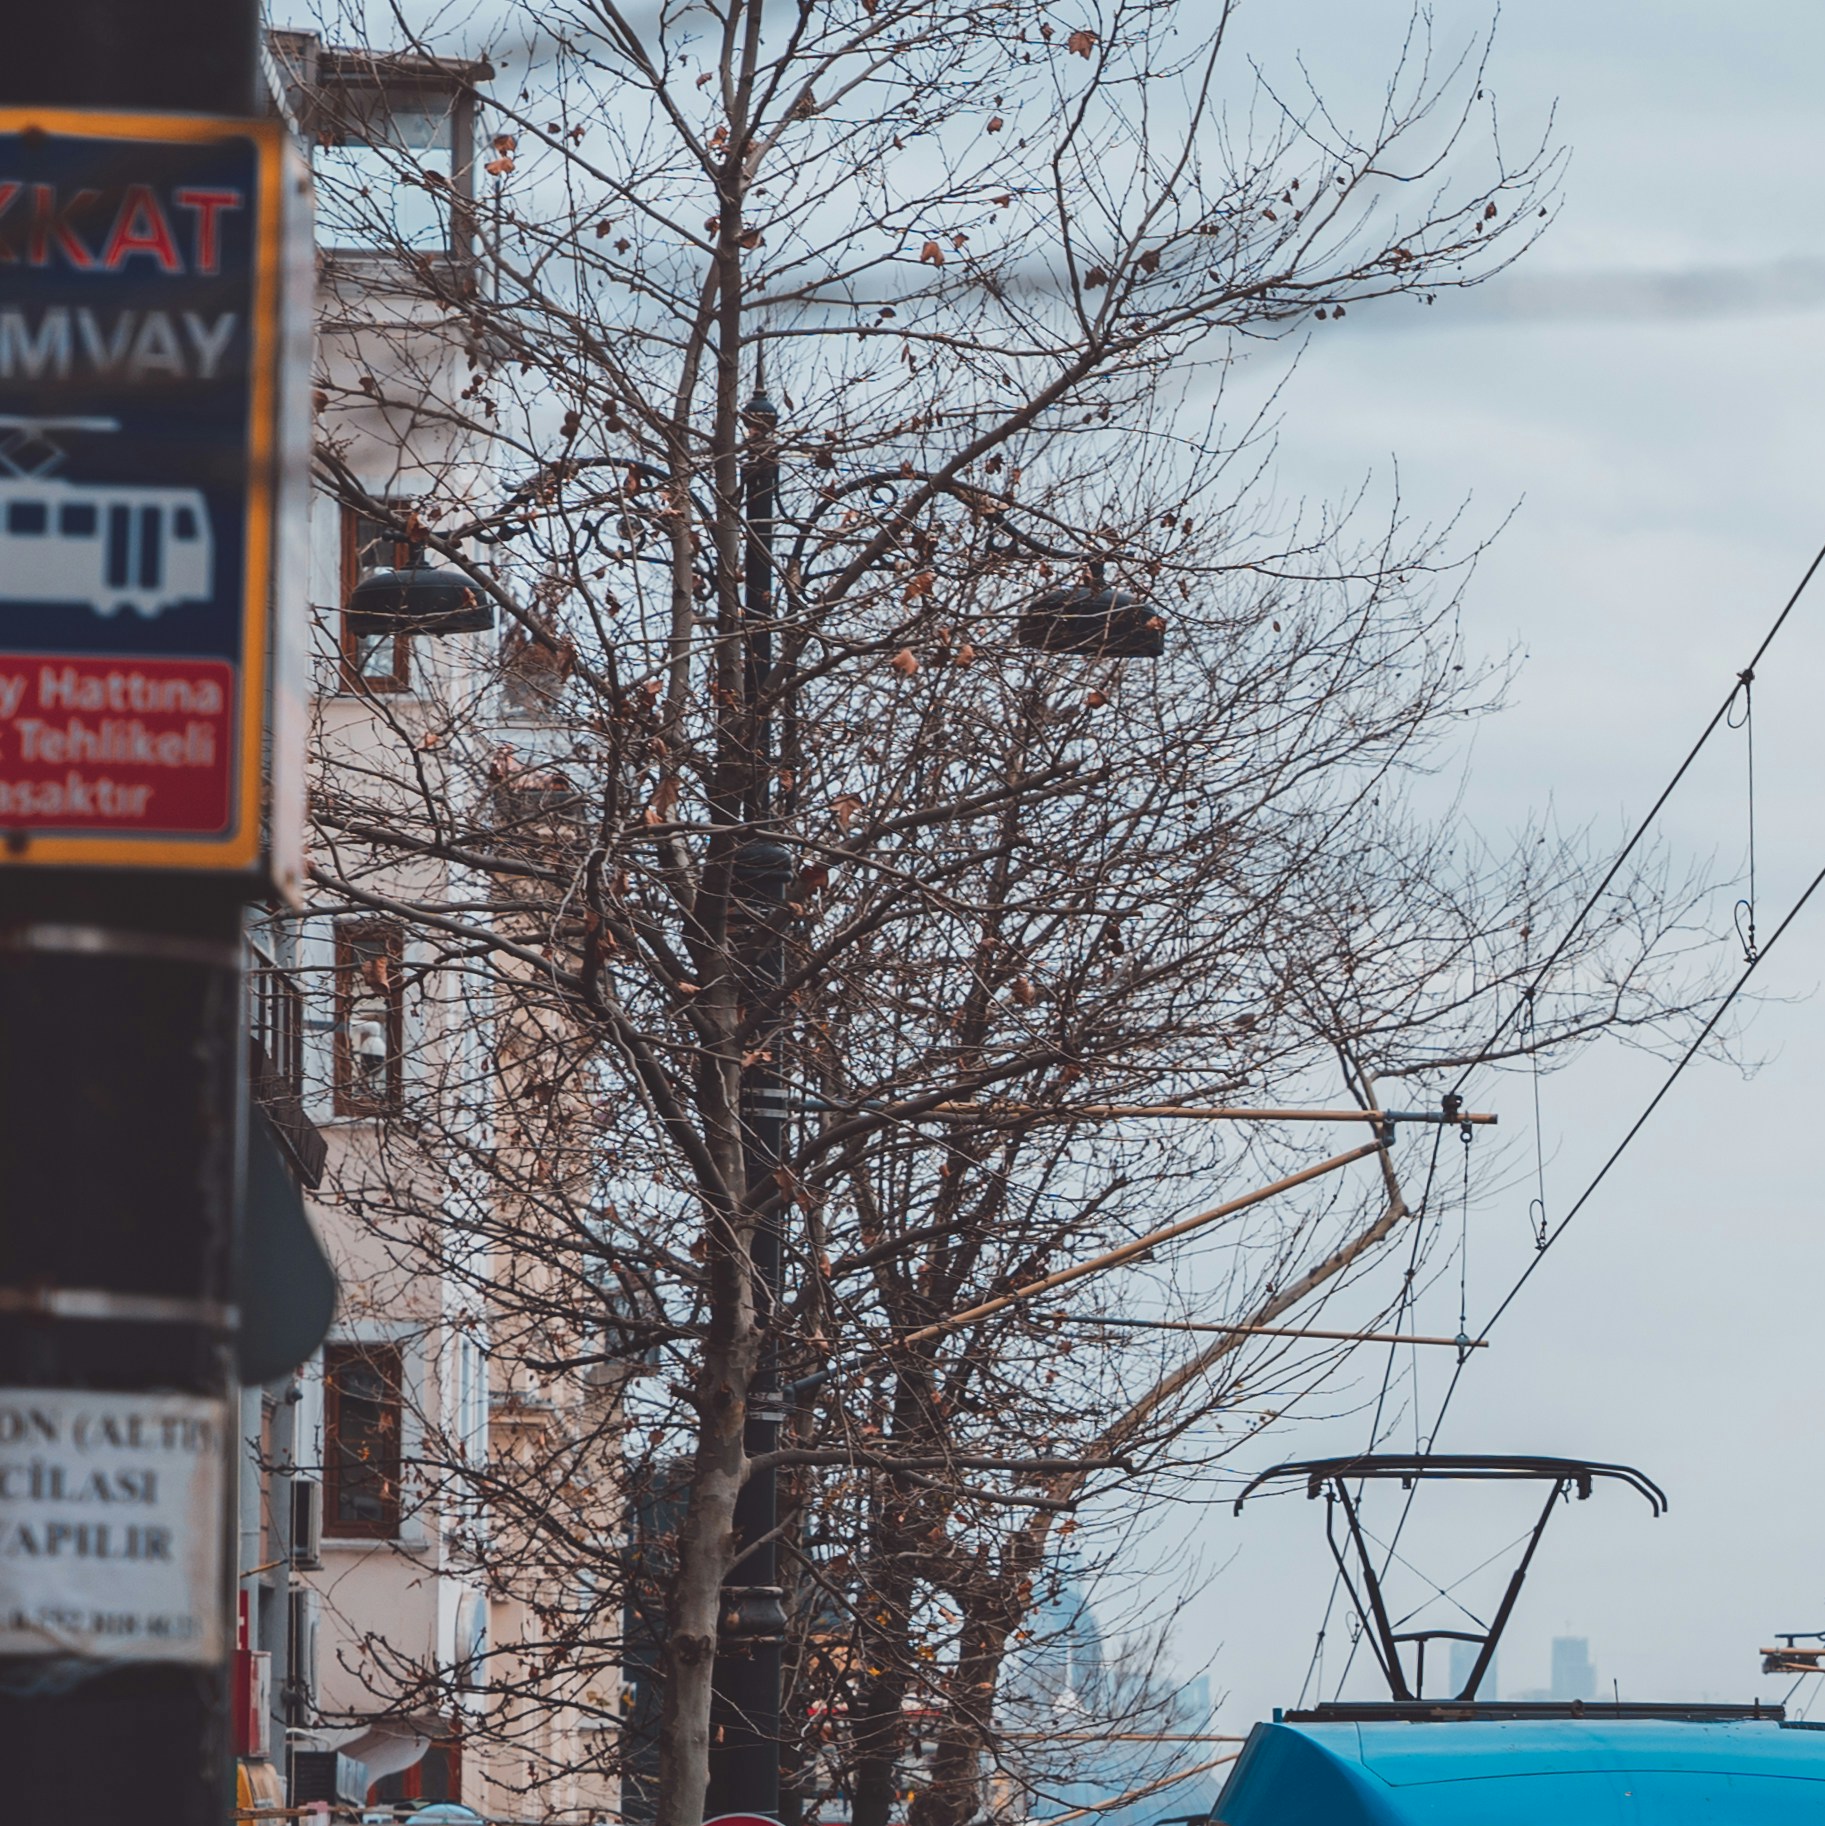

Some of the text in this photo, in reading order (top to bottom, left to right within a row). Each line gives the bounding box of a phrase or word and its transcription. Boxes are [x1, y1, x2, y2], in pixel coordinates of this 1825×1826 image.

[40, 666, 223, 714] Hattına
[15, 716, 216, 768] Tehlikeli
[4, 1521, 174, 1563] APILIR
